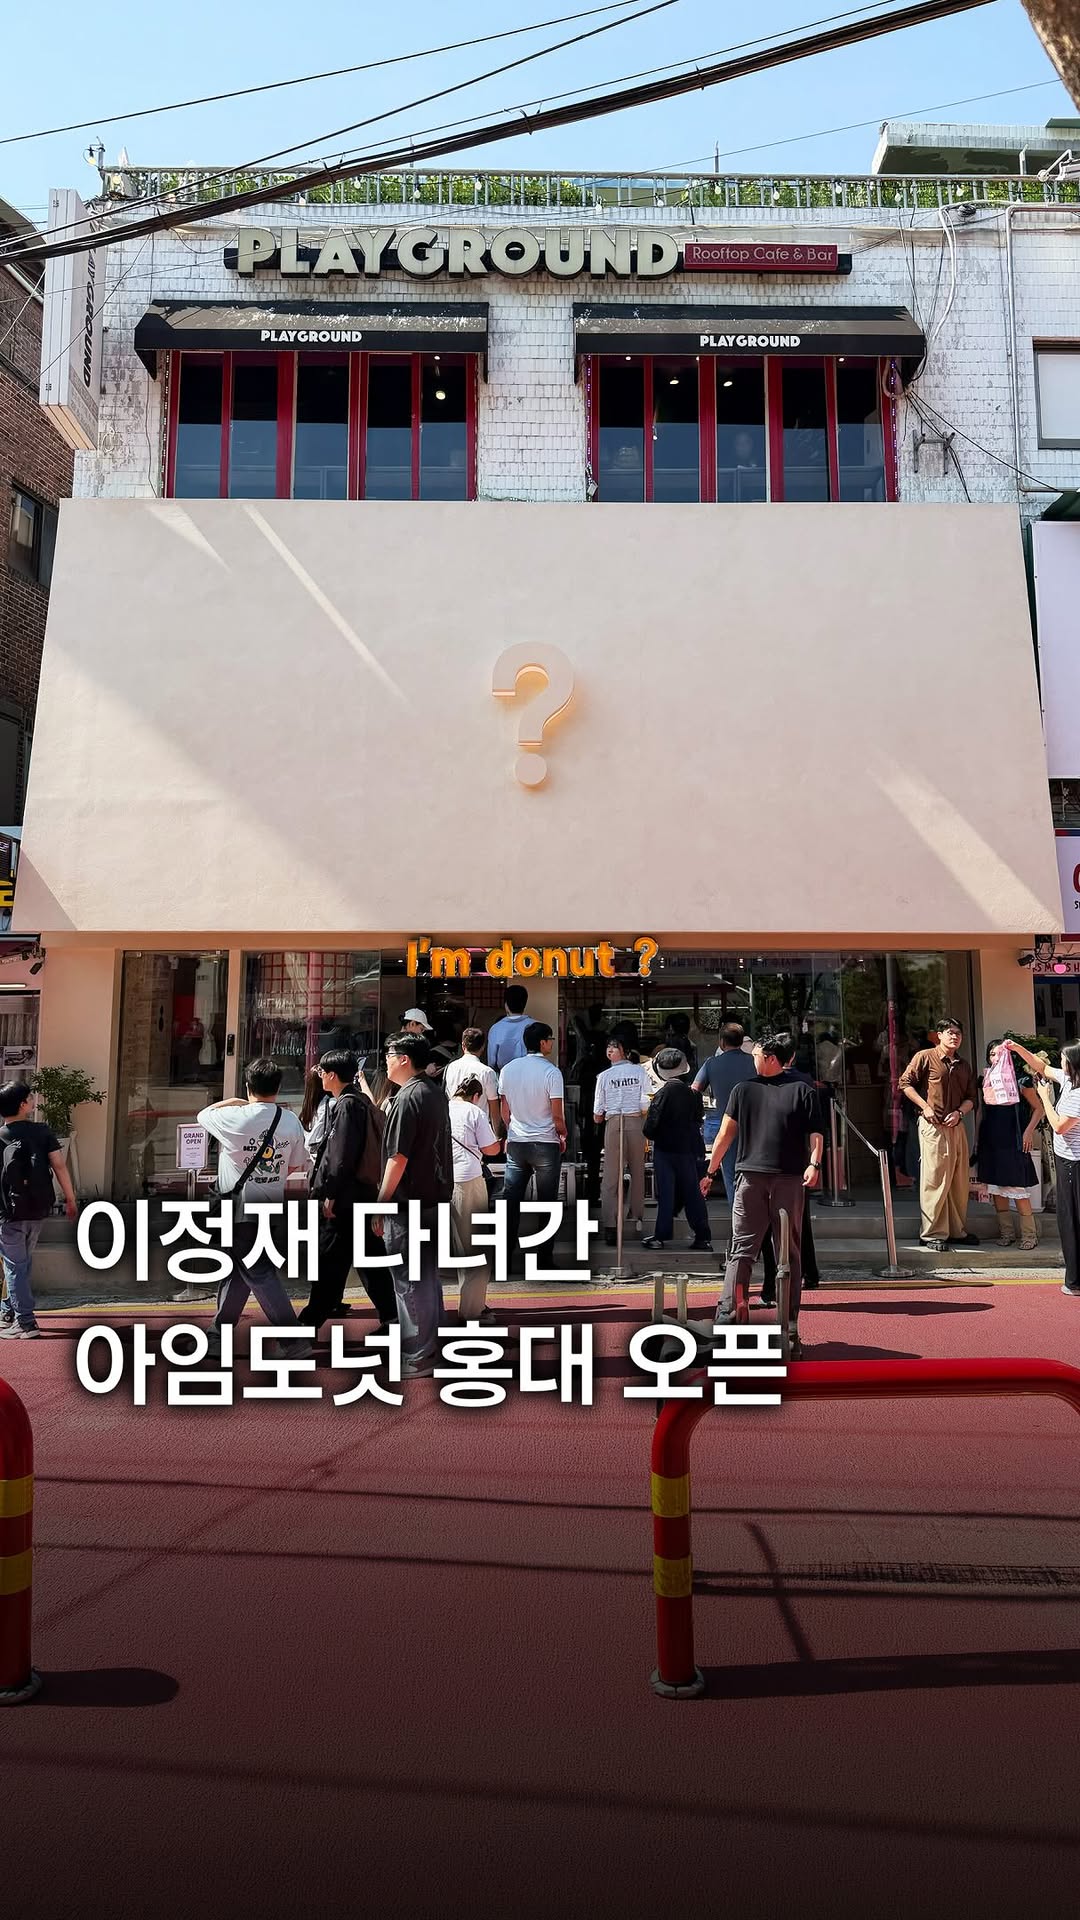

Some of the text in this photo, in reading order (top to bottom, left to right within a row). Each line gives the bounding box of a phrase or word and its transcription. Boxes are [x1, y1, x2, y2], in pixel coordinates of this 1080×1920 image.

[237, 227, 679, 279] PLAYGROUND
[692, 246, 833, 262] Rooftop Cafe & Bar
[260, 329, 363, 343] PLAYGROUND
[699, 334, 801, 348] PLAYGROUND
[491, 641, 576, 786] ?
[407, 937, 471, 977] I'm
[485, 939, 616, 979] donut
[633, 936, 658, 977] ?
